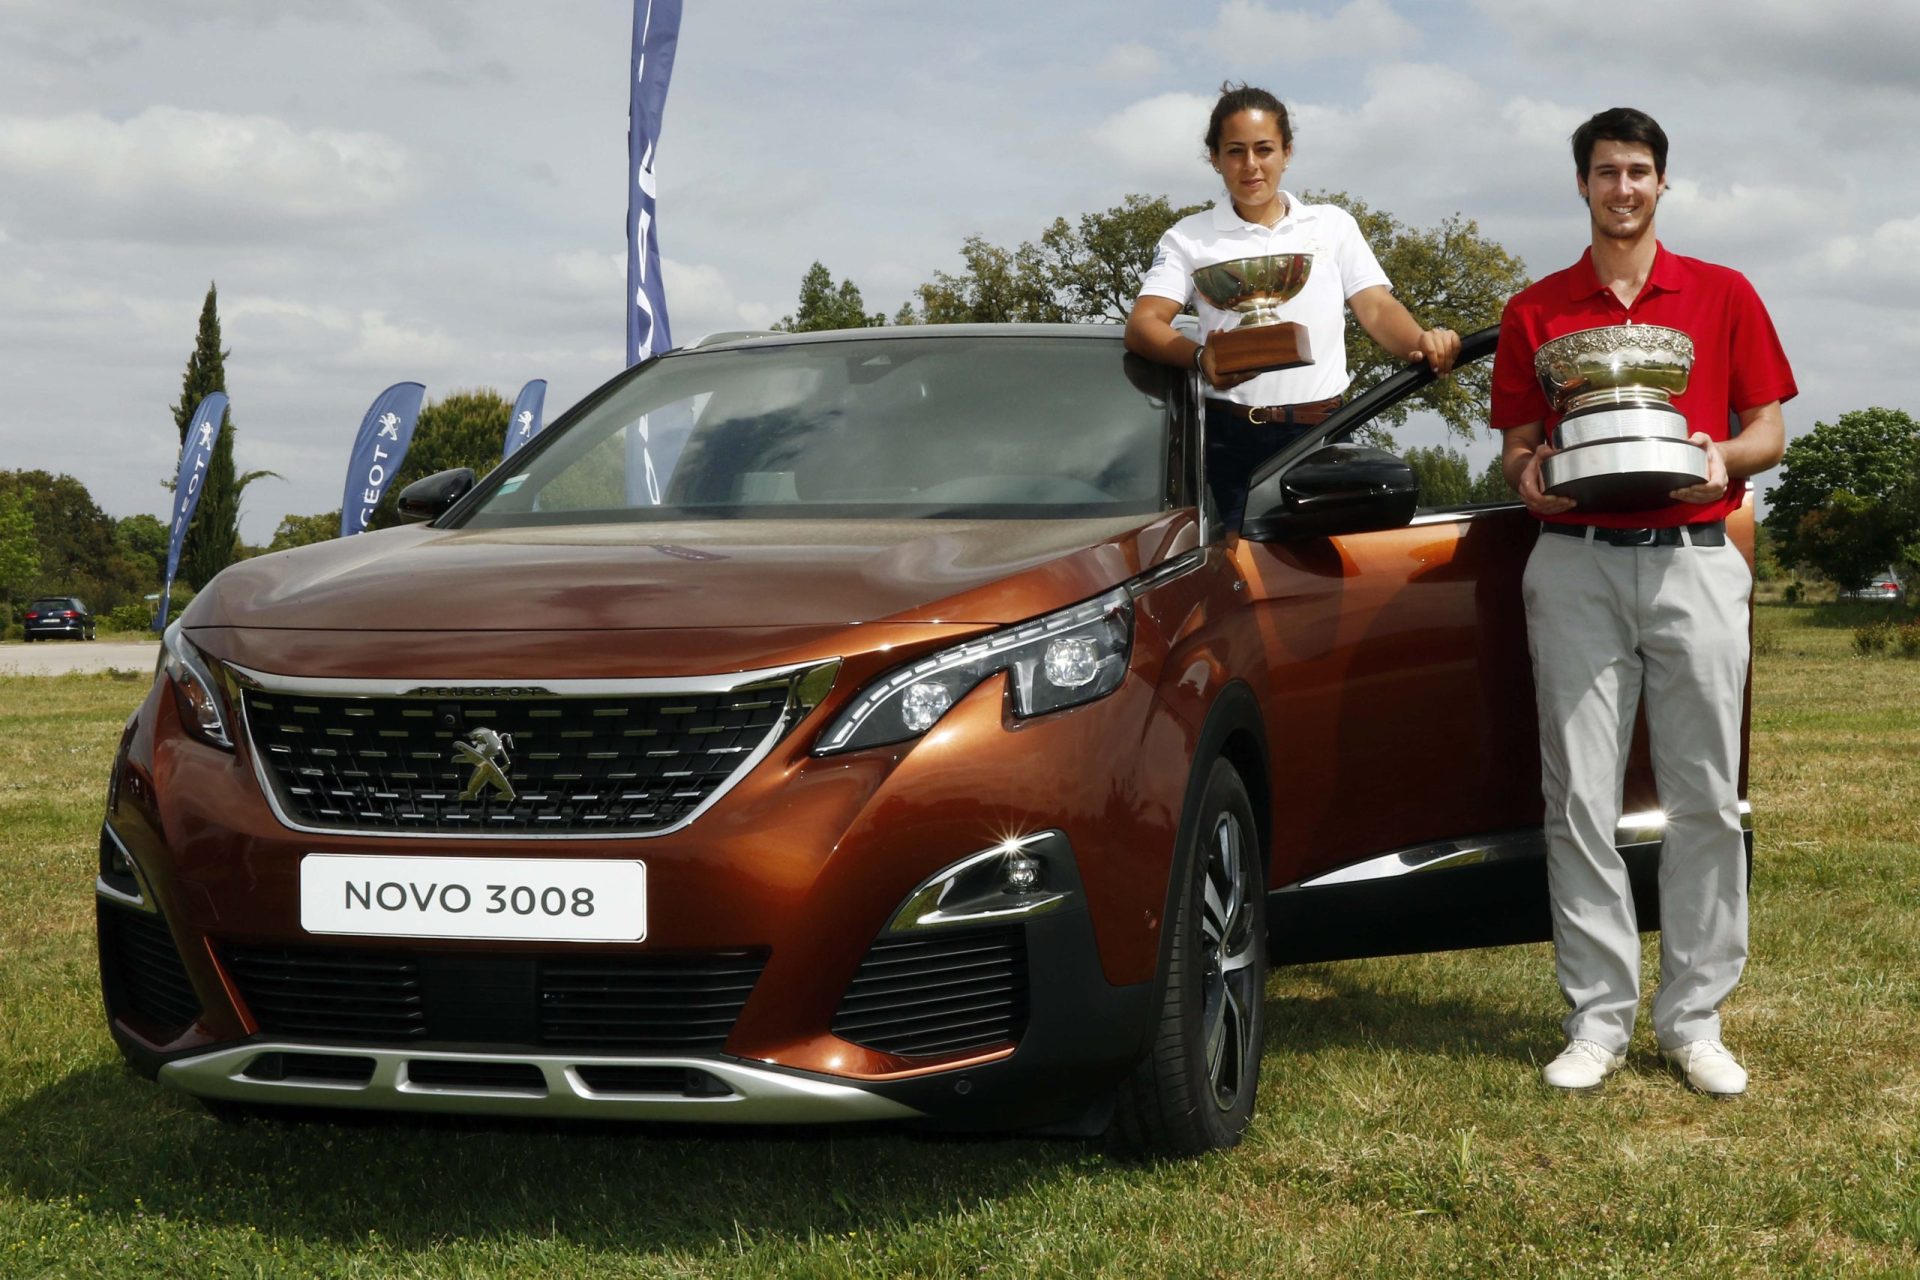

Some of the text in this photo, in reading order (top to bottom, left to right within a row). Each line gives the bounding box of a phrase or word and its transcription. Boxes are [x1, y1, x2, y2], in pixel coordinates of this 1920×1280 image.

[418, 686, 542, 697] PEUGEOT
[345, 880, 595, 917] NOVO 3008
